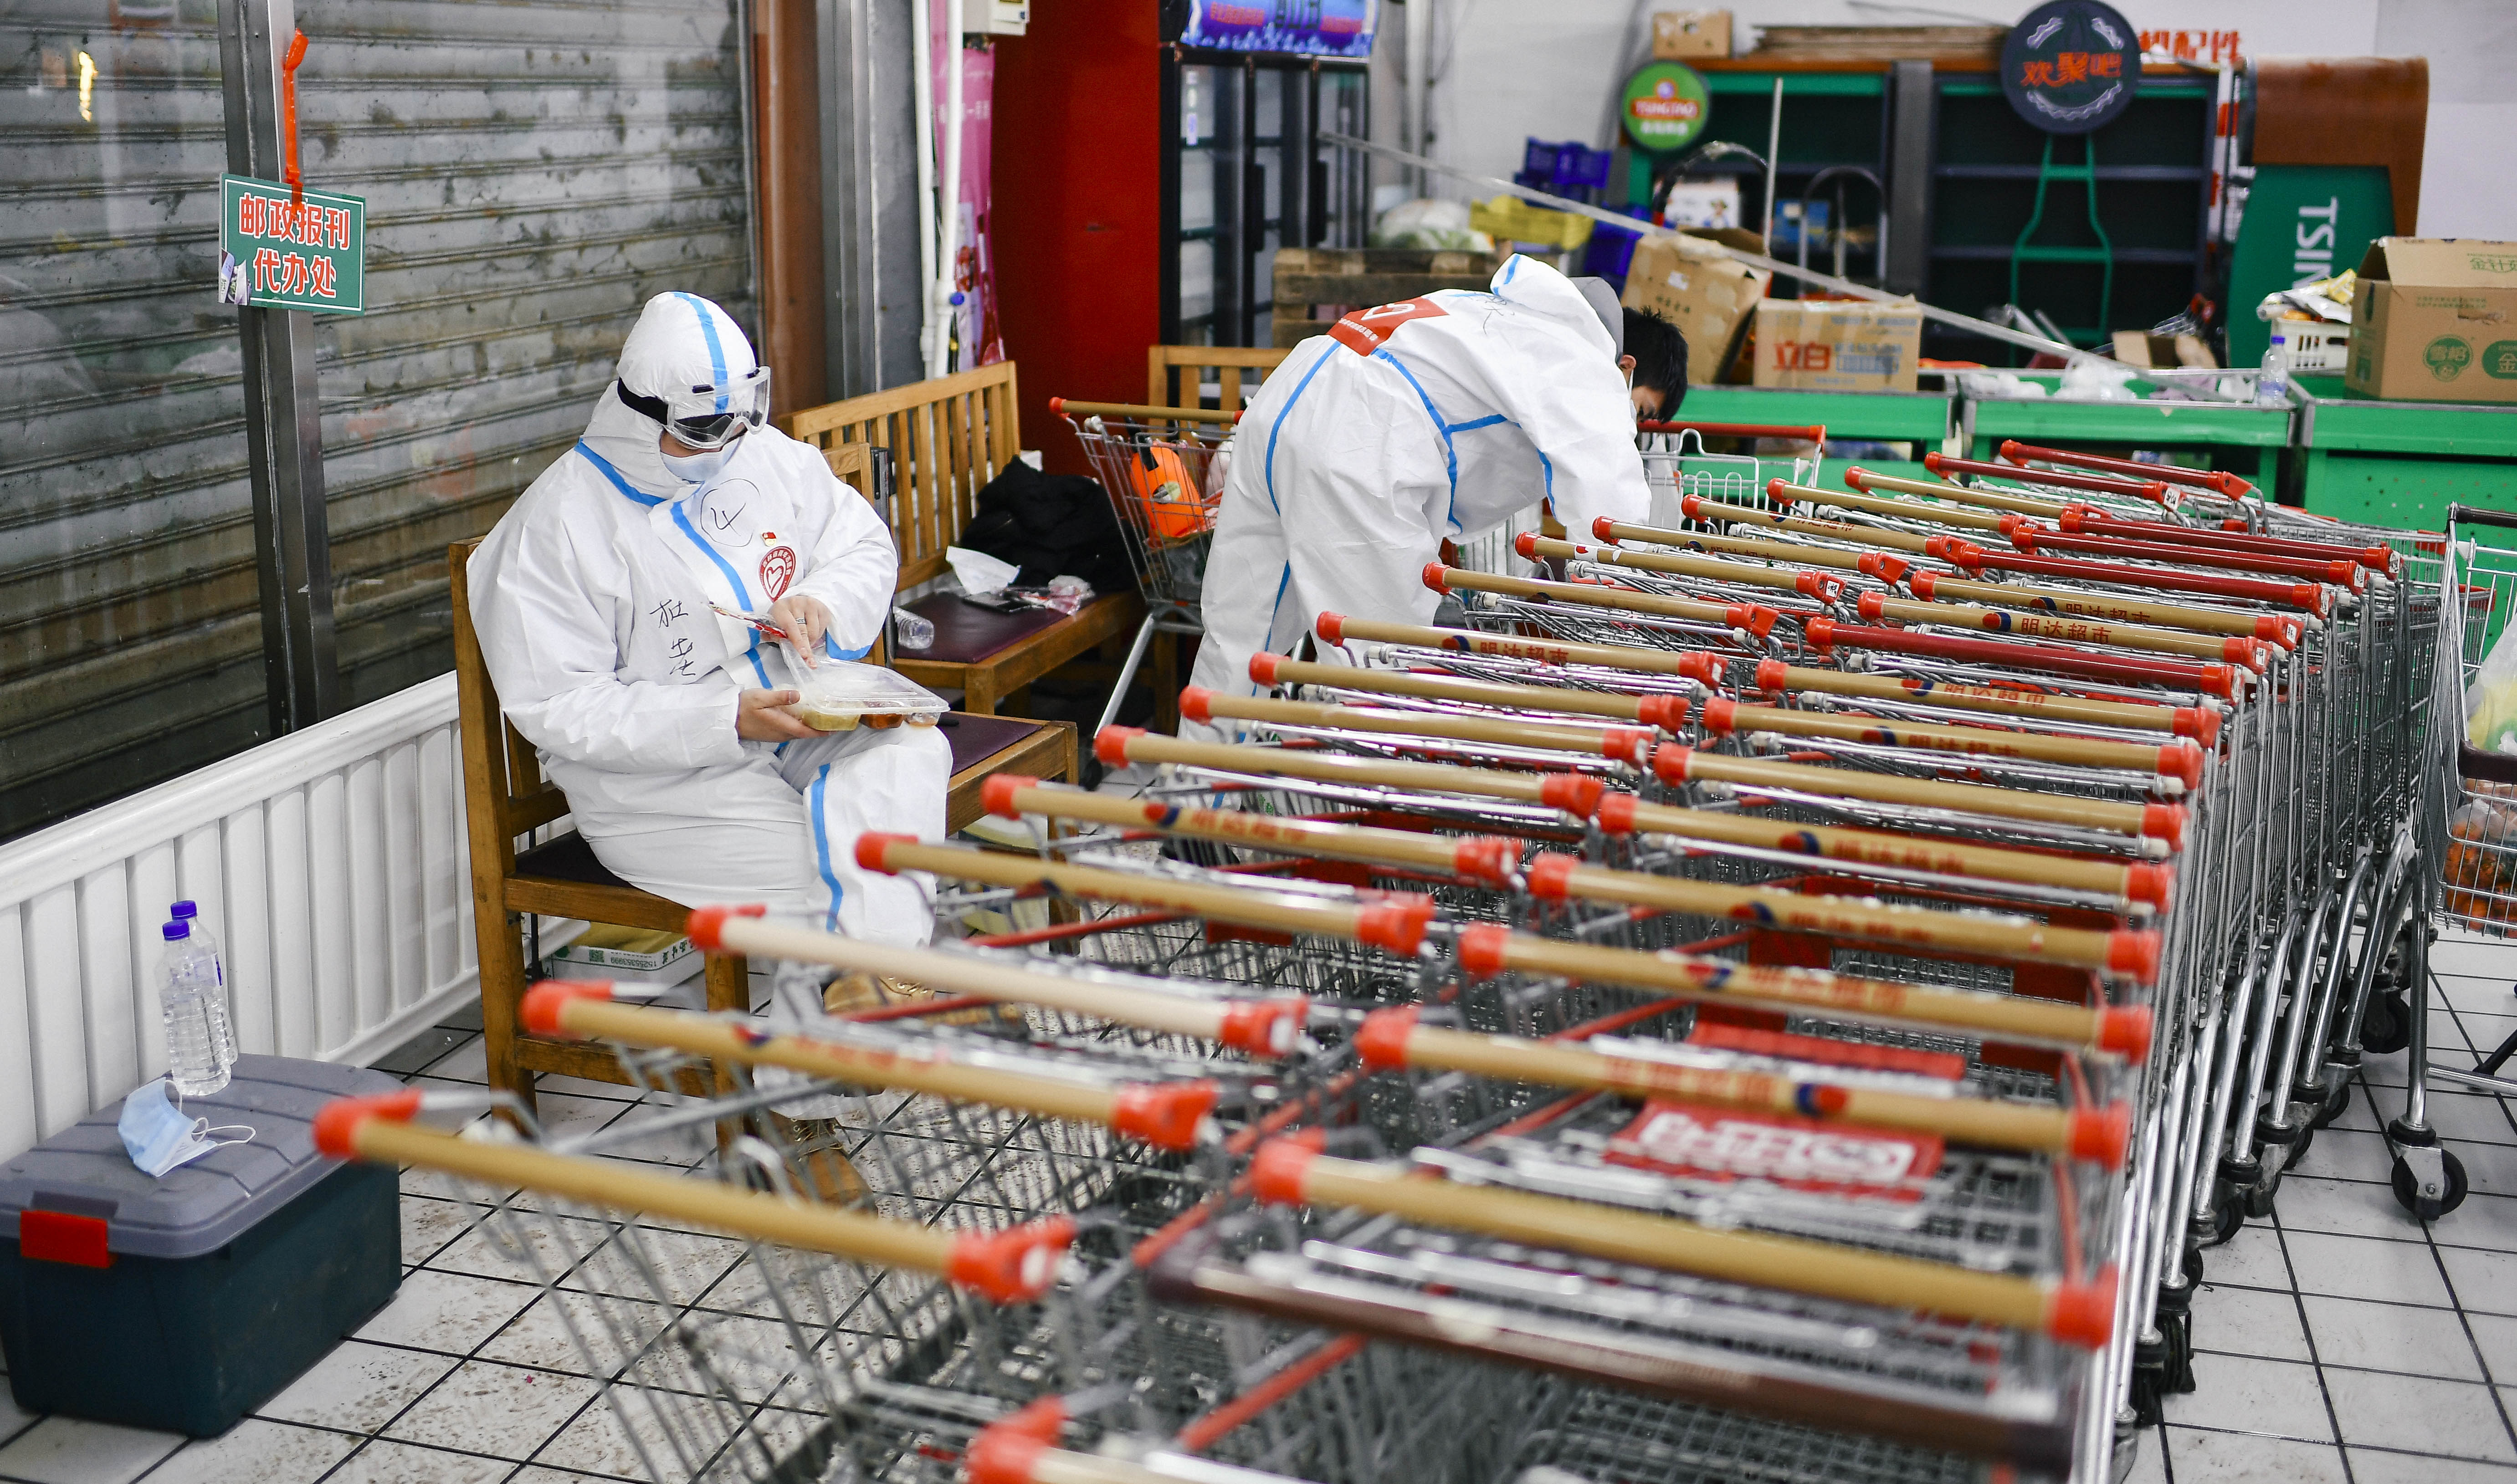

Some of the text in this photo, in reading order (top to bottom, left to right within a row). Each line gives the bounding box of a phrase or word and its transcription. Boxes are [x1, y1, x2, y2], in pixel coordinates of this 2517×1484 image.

[2020, 52, 2122, 87] 欢聚吧
[239, 192, 351, 251] 邮政报刊
[252, 247, 338, 298] 代办处
[1773, 340, 1831, 371] 立白
[710, 502, 746, 536] 4
[2021, 618, 2112, 644] 明达超市
